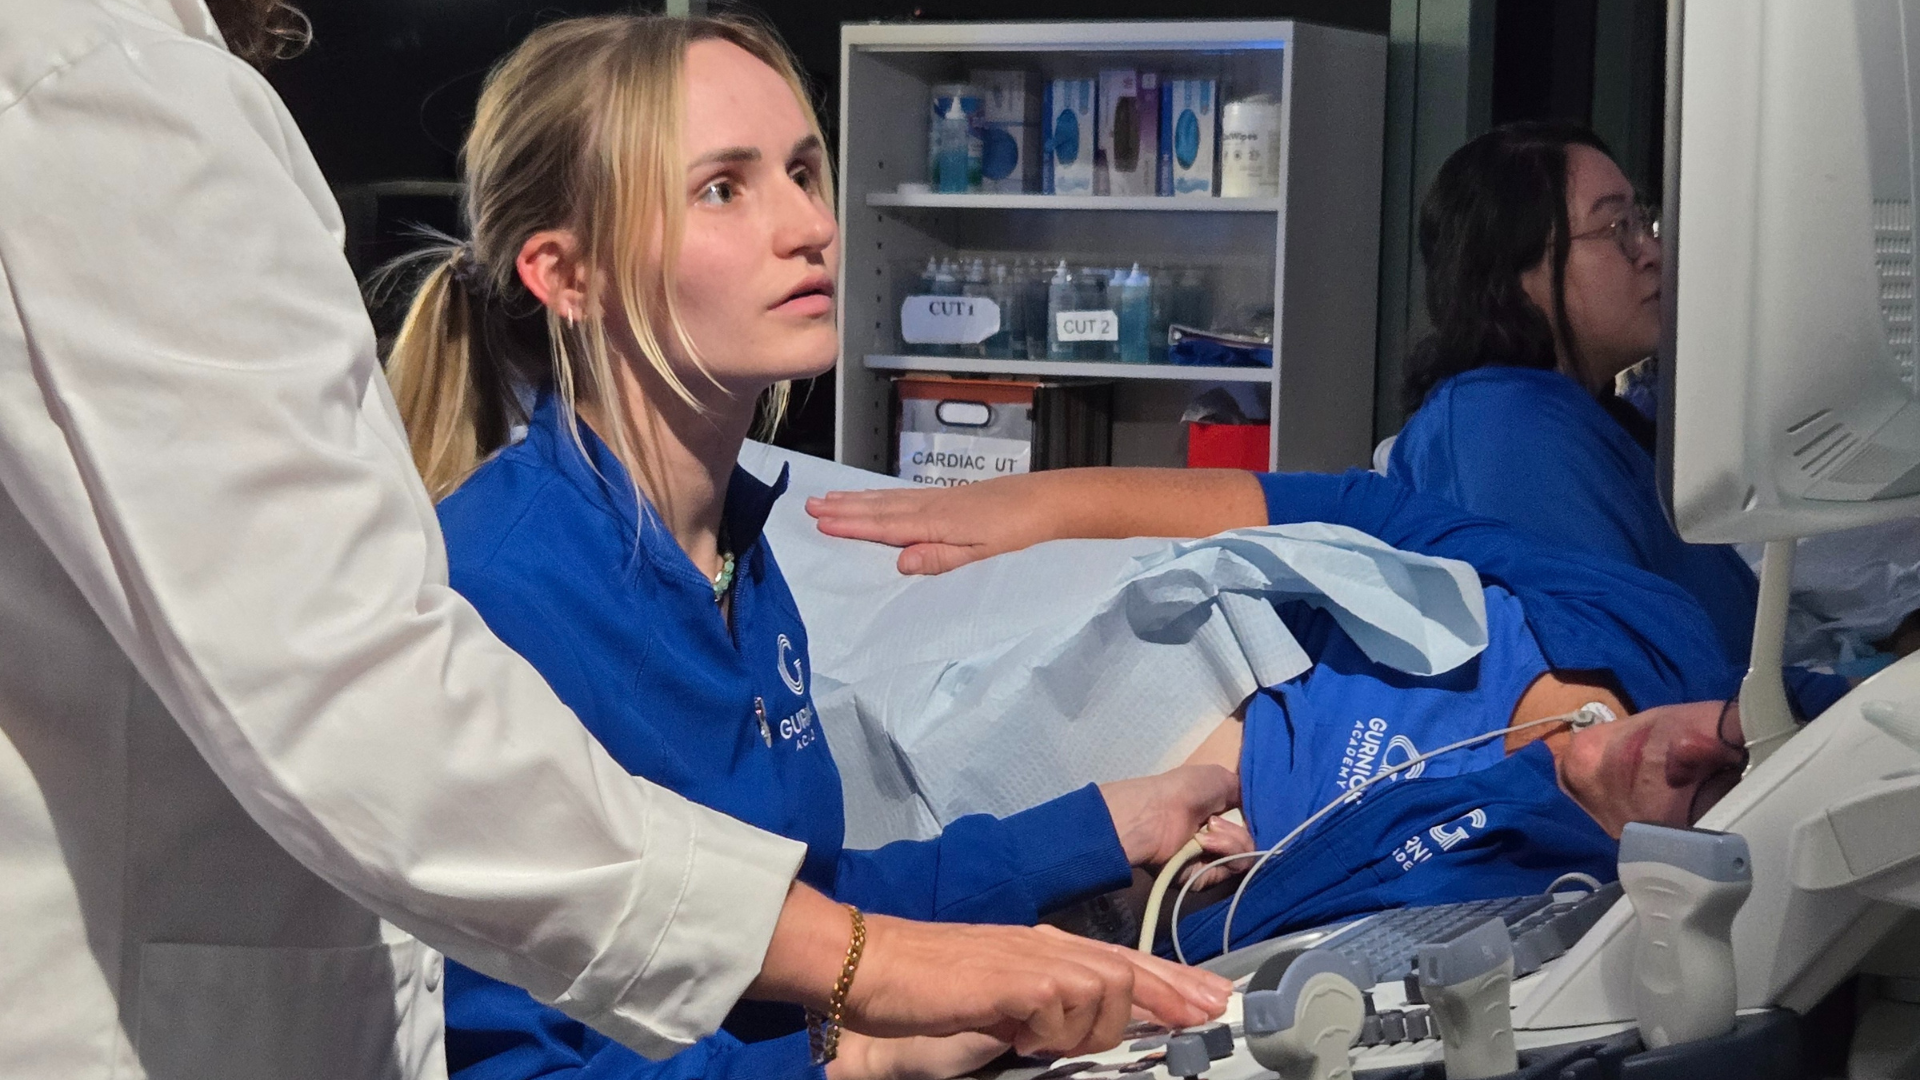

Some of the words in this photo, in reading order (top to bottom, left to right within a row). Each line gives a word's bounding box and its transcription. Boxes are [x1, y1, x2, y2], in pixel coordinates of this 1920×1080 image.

[928, 301, 965, 316] CUT
[967, 304, 975, 317] 1
[1063, 319, 1097, 335] CUT
[1101, 319, 1111, 335] 2
[912, 451, 986, 471] CARDIAC
[995, 457, 1018, 473] UT
[912, 475, 980, 488] PROTO
[1336, 720, 1365, 790] ACADEMY
